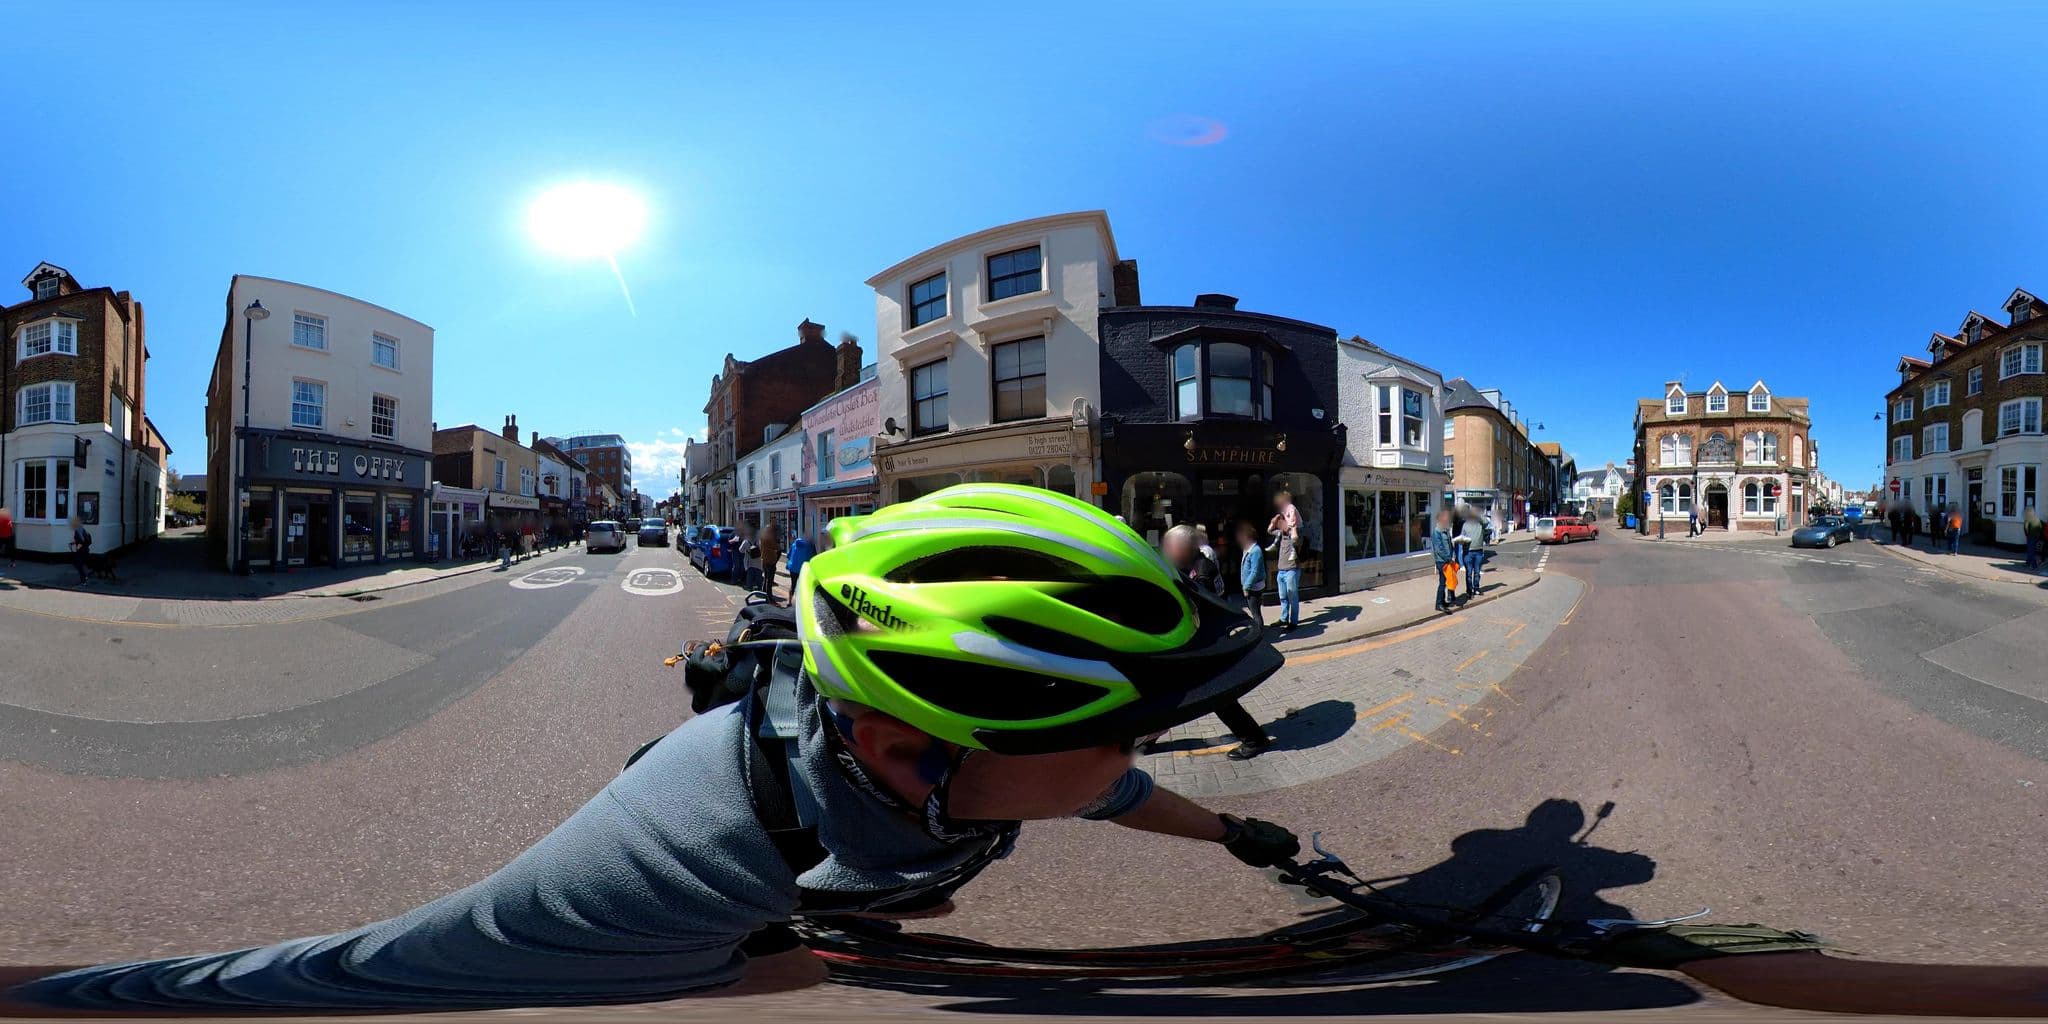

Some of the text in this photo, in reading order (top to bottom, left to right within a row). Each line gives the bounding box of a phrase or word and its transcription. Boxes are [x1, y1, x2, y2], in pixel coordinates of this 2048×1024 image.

[837, 396, 860, 419] Oyster
[860, 388, 878, 407] Bar
[292, 448, 405, 480] THE OFFY
[1186, 449, 1276, 463] SAMPHIRE
